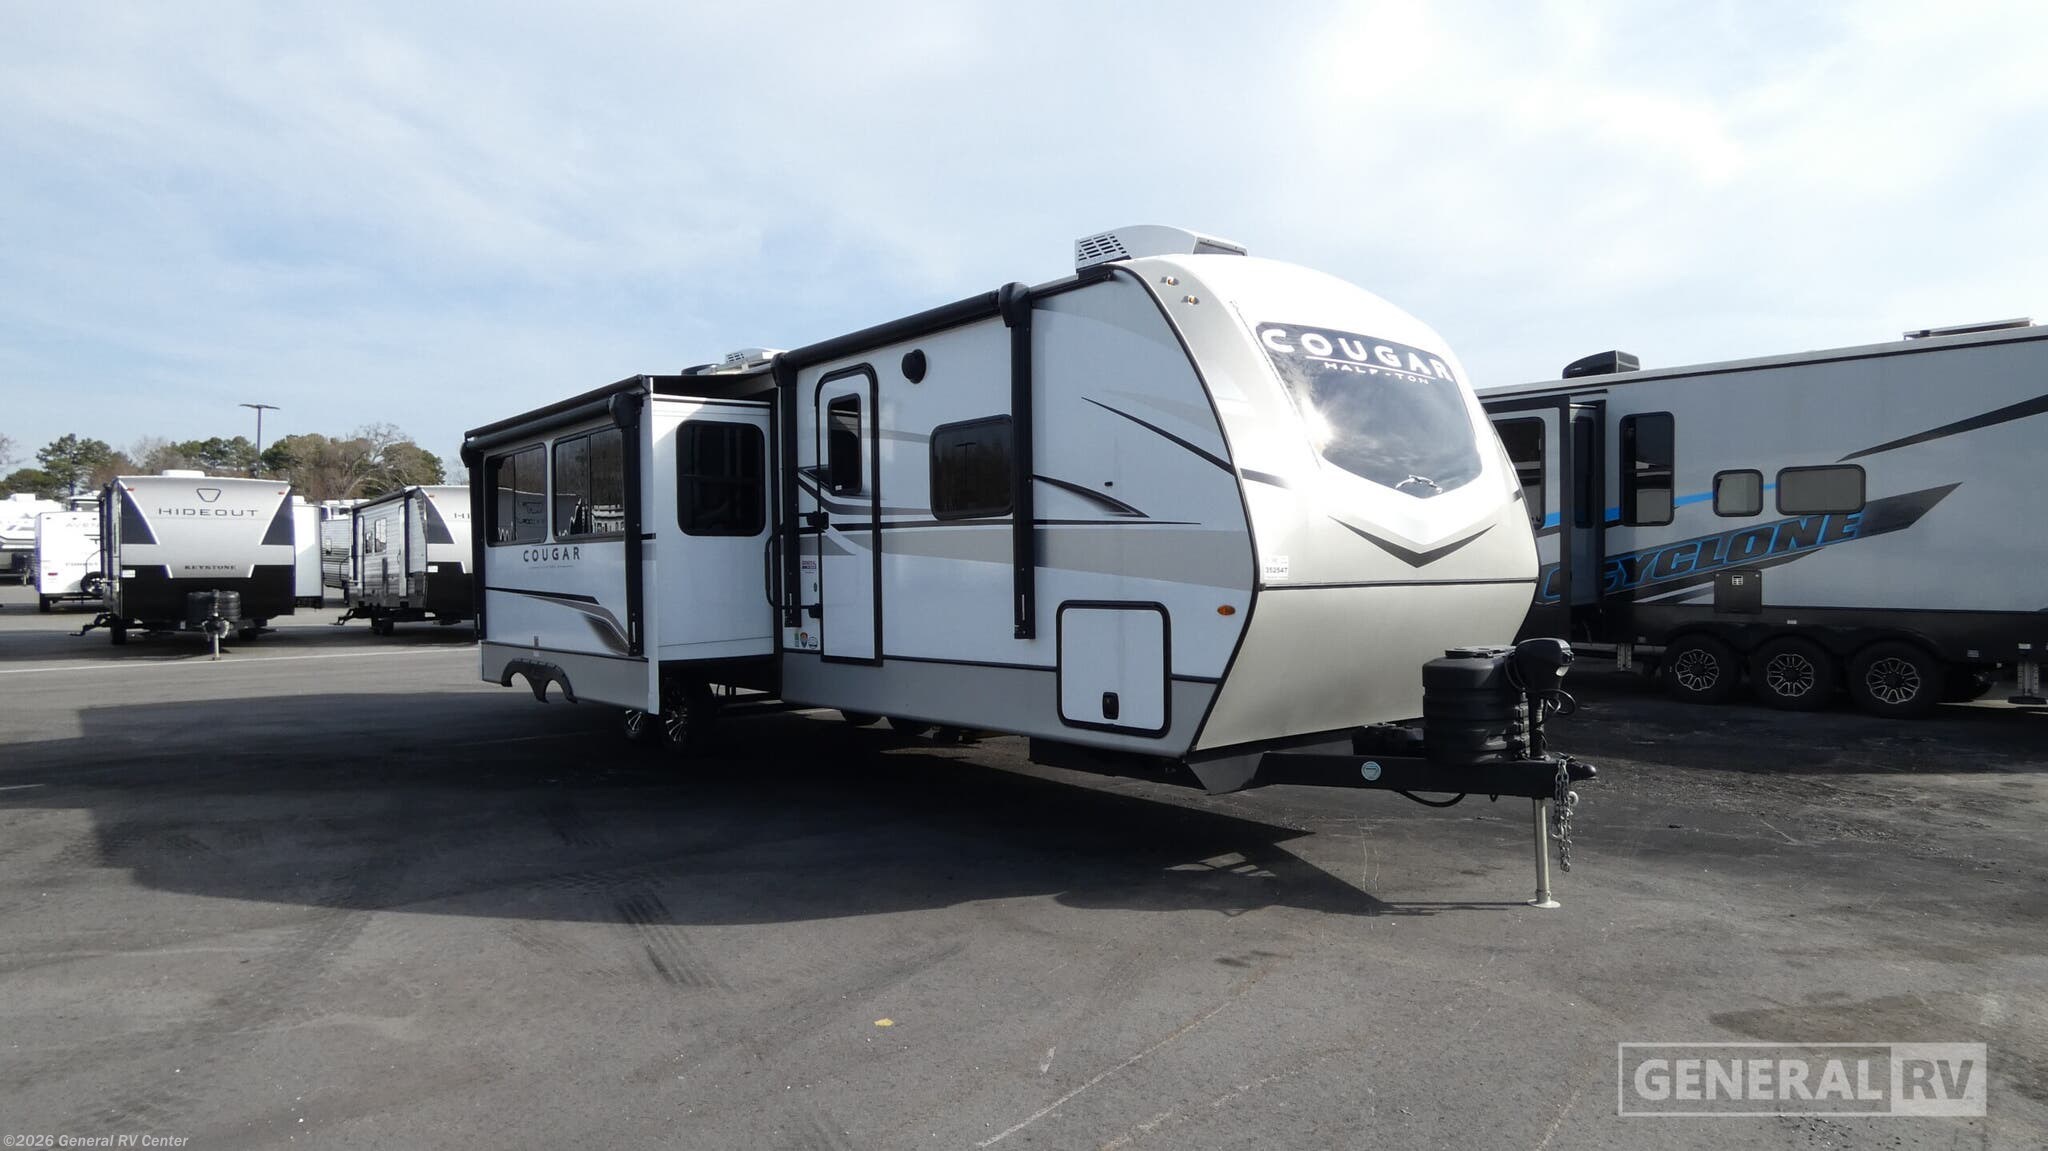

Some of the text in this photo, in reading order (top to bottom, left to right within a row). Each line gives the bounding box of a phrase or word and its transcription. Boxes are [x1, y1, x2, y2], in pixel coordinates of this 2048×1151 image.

[1261, 328, 1455, 382] COUGAR
[158, 508, 259, 517] HIDEOUT
[523, 546, 580, 562] COUGAR
